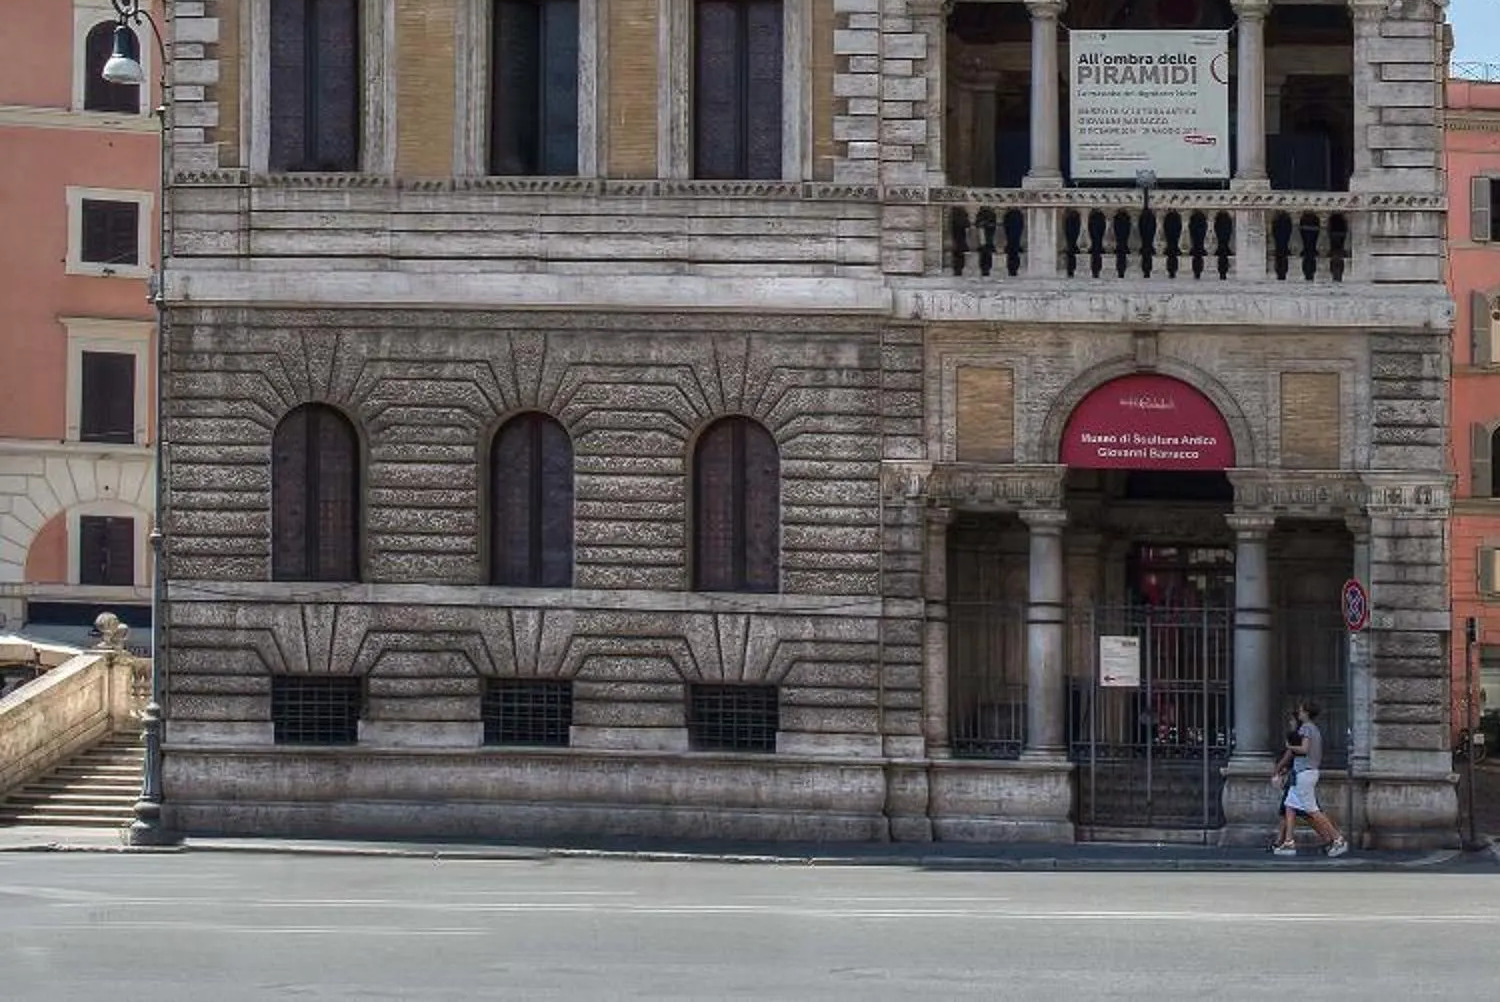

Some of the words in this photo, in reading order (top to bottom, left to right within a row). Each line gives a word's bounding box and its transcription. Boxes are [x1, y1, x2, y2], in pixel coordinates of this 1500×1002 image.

[1078, 53, 1153, 64] All'ombra
[1158, 53, 1197, 64] delle
[1078, 66, 1197, 84] PIRAMIDI
[1081, 433, 1117, 443] Museo
[1120, 433, 1131, 443] di
[1133, 433, 1179, 445] Scultura
[1181, 435, 1217, 446] Antica
[1097, 447, 1147, 458] Giovanni
[1149, 447, 1199, 459] Barracco
